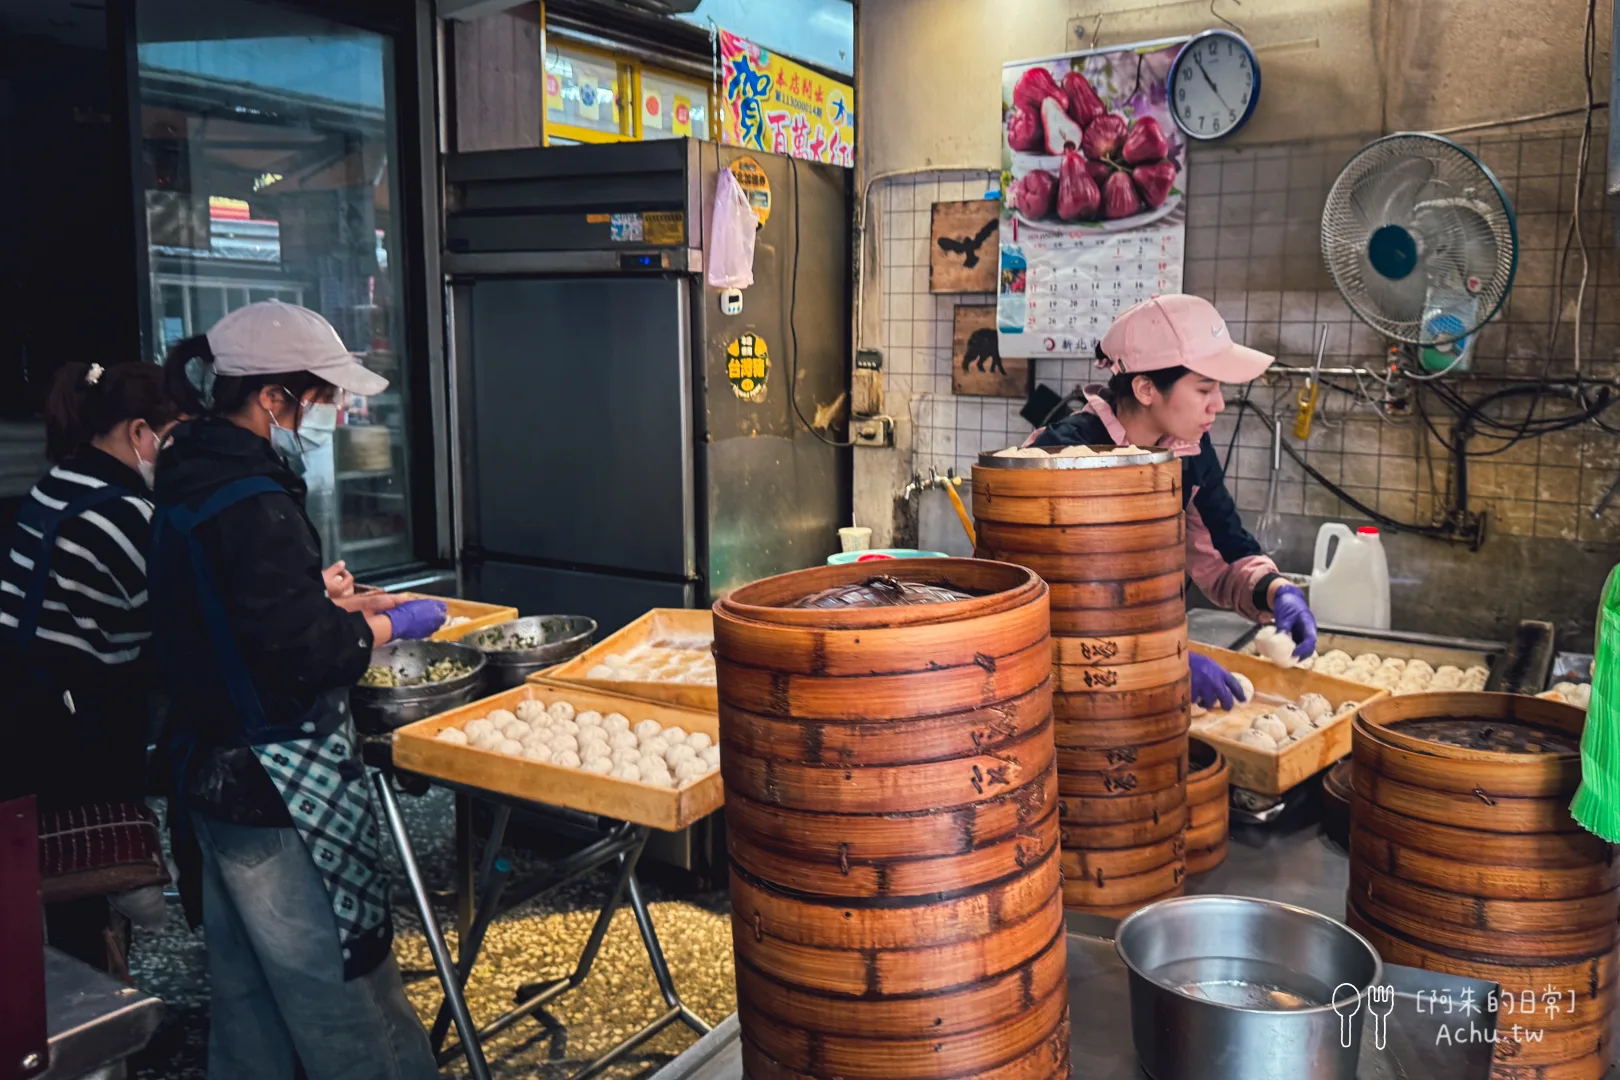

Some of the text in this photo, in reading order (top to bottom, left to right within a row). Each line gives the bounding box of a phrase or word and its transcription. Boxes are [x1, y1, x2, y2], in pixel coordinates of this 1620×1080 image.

[1208, 39, 1218, 56] 12
[1228, 39, 1233, 57] 1
[1239, 53, 1247, 69] 2
[1182, 66, 1193, 82] 10
[1179, 88, 1186, 102] 9
[1240, 92, 1248, 105] 4
[728, 54, 771, 152] 賀
[1184, 105, 1192, 119] 8
[1229, 108, 1237, 123] 5
[1198, 115, 1205, 130] 7
[1213, 117, 1220, 132] 6
[767, 113, 853, 167] 百萬大紅
[1050, 283, 1057, 292] 12
